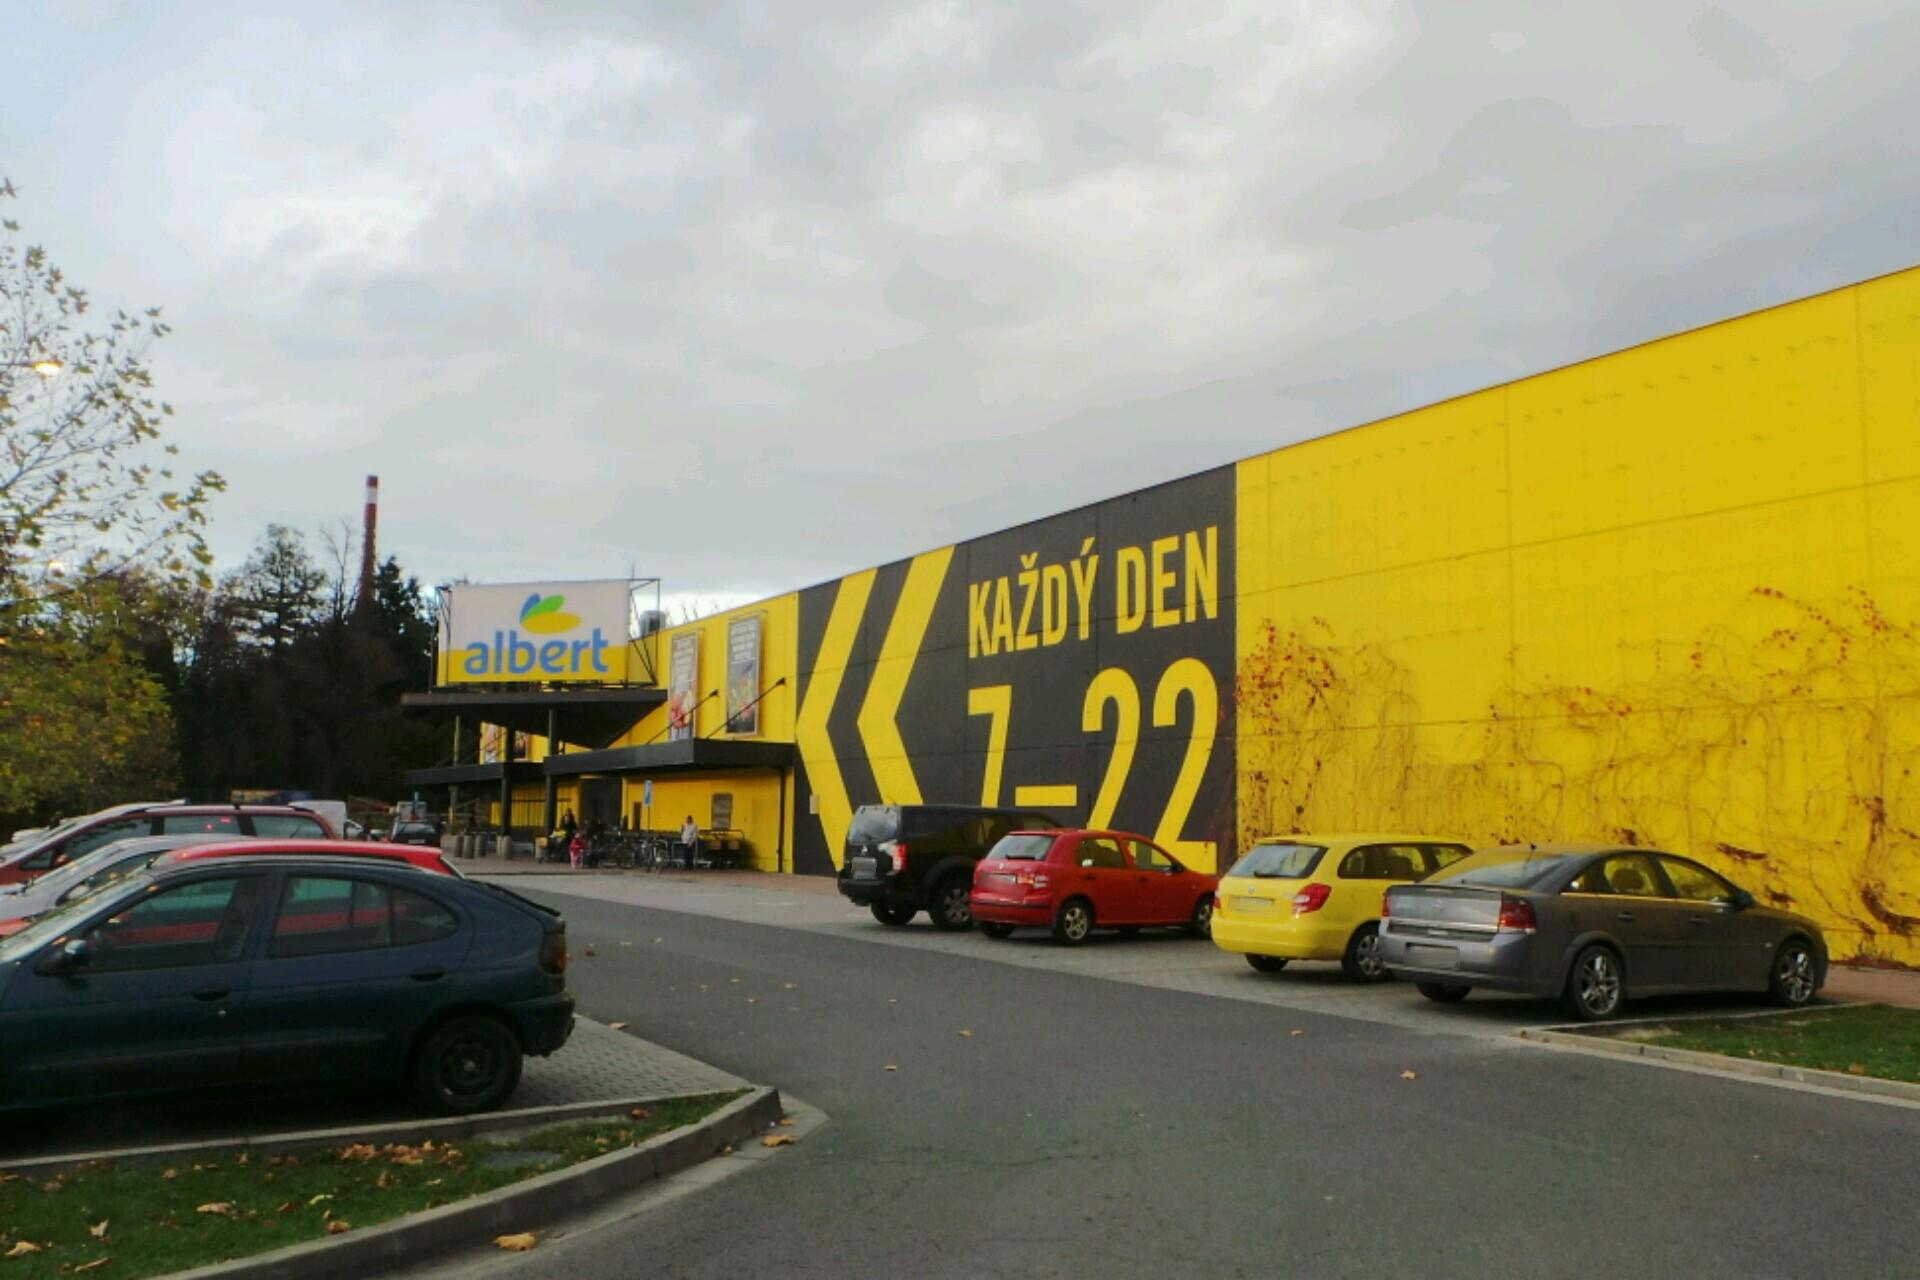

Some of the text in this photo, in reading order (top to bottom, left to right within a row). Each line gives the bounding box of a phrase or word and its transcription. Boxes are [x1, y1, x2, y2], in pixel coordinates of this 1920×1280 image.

[969, 526, 1218, 657] KAŽDÝ DEN
[465, 628, 609, 674] albert
